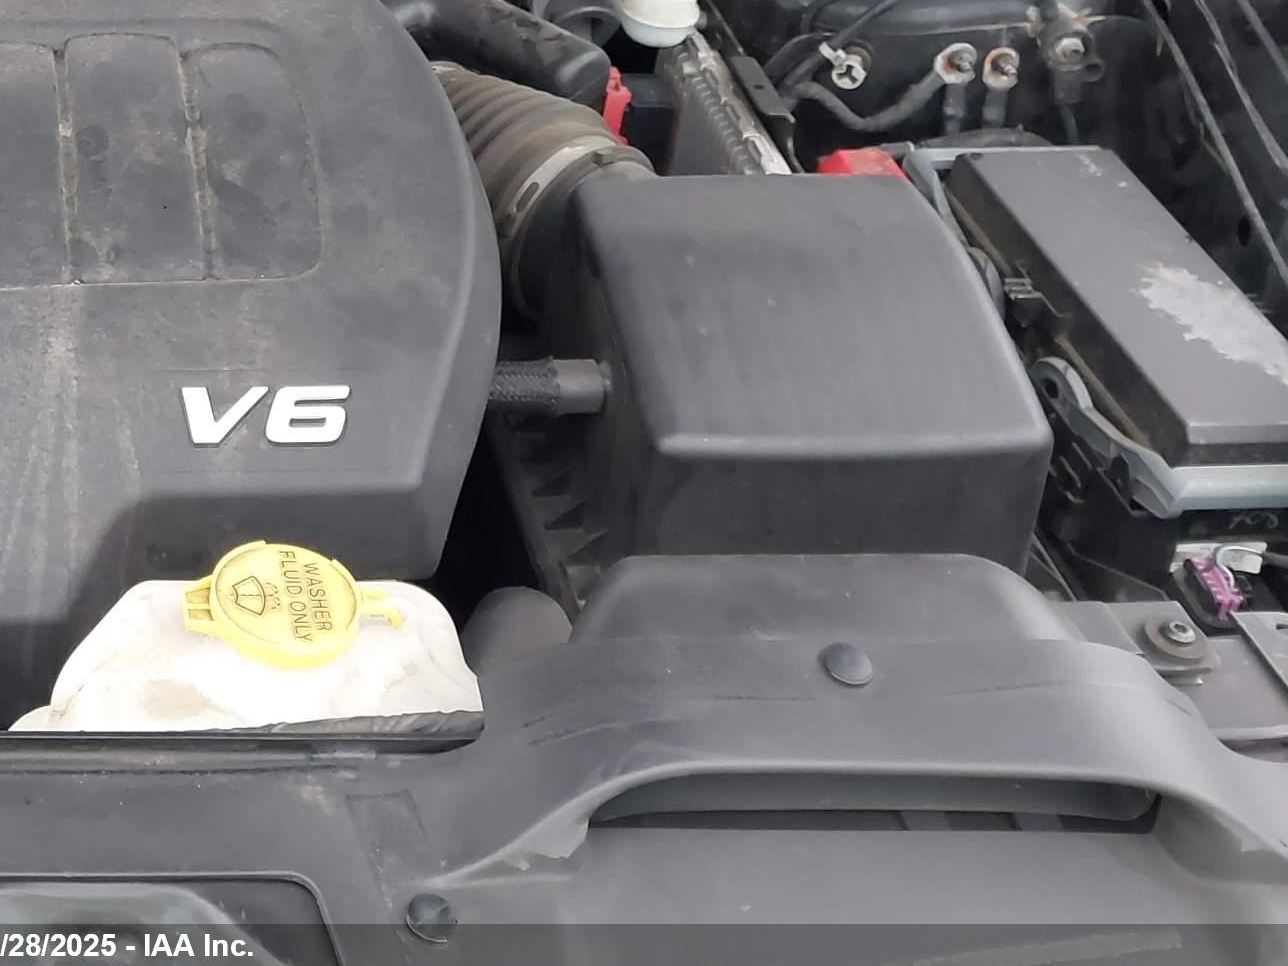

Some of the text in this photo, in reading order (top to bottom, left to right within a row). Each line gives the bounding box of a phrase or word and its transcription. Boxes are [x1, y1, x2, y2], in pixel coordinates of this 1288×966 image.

[180, 385, 351, 448] V6
[278, 550, 314, 642] FLUID ONLY
[303, 562, 334, 632] WASHER
